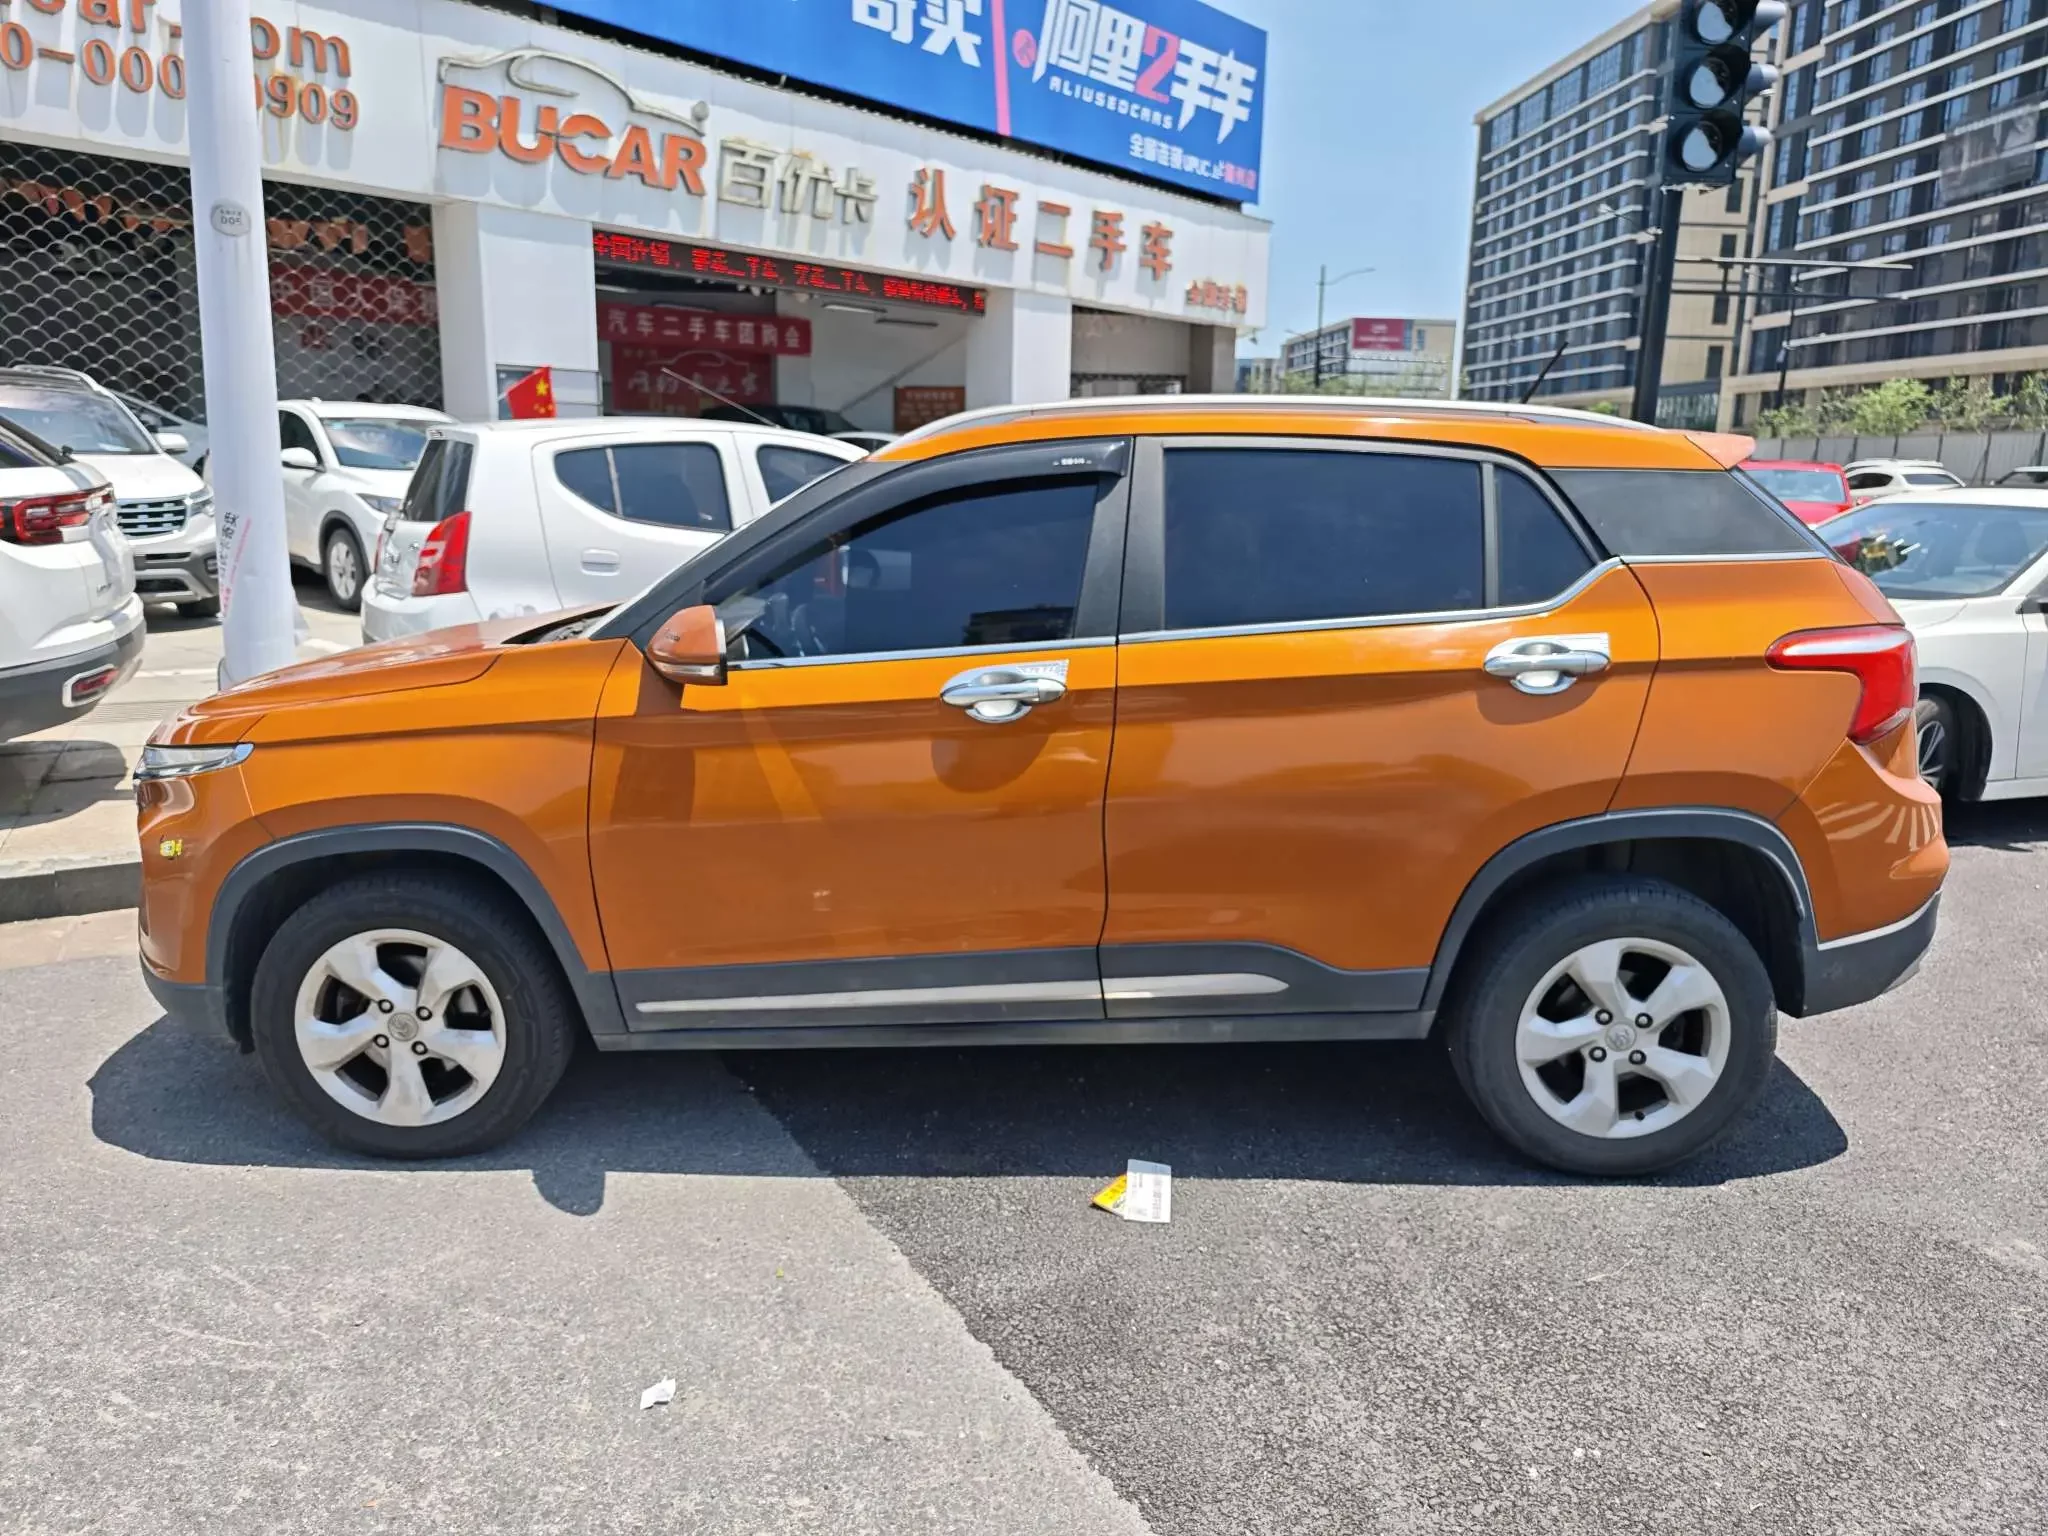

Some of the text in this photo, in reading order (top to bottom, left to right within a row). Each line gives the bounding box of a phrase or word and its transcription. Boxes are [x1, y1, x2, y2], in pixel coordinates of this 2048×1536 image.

[439, 85, 708, 196] BUCAR
[1049, 76, 1173, 130] ALIUSEDCARS
[717, 136, 878, 224] 百优卡
[908, 168, 1174, 281] 认证二手车
